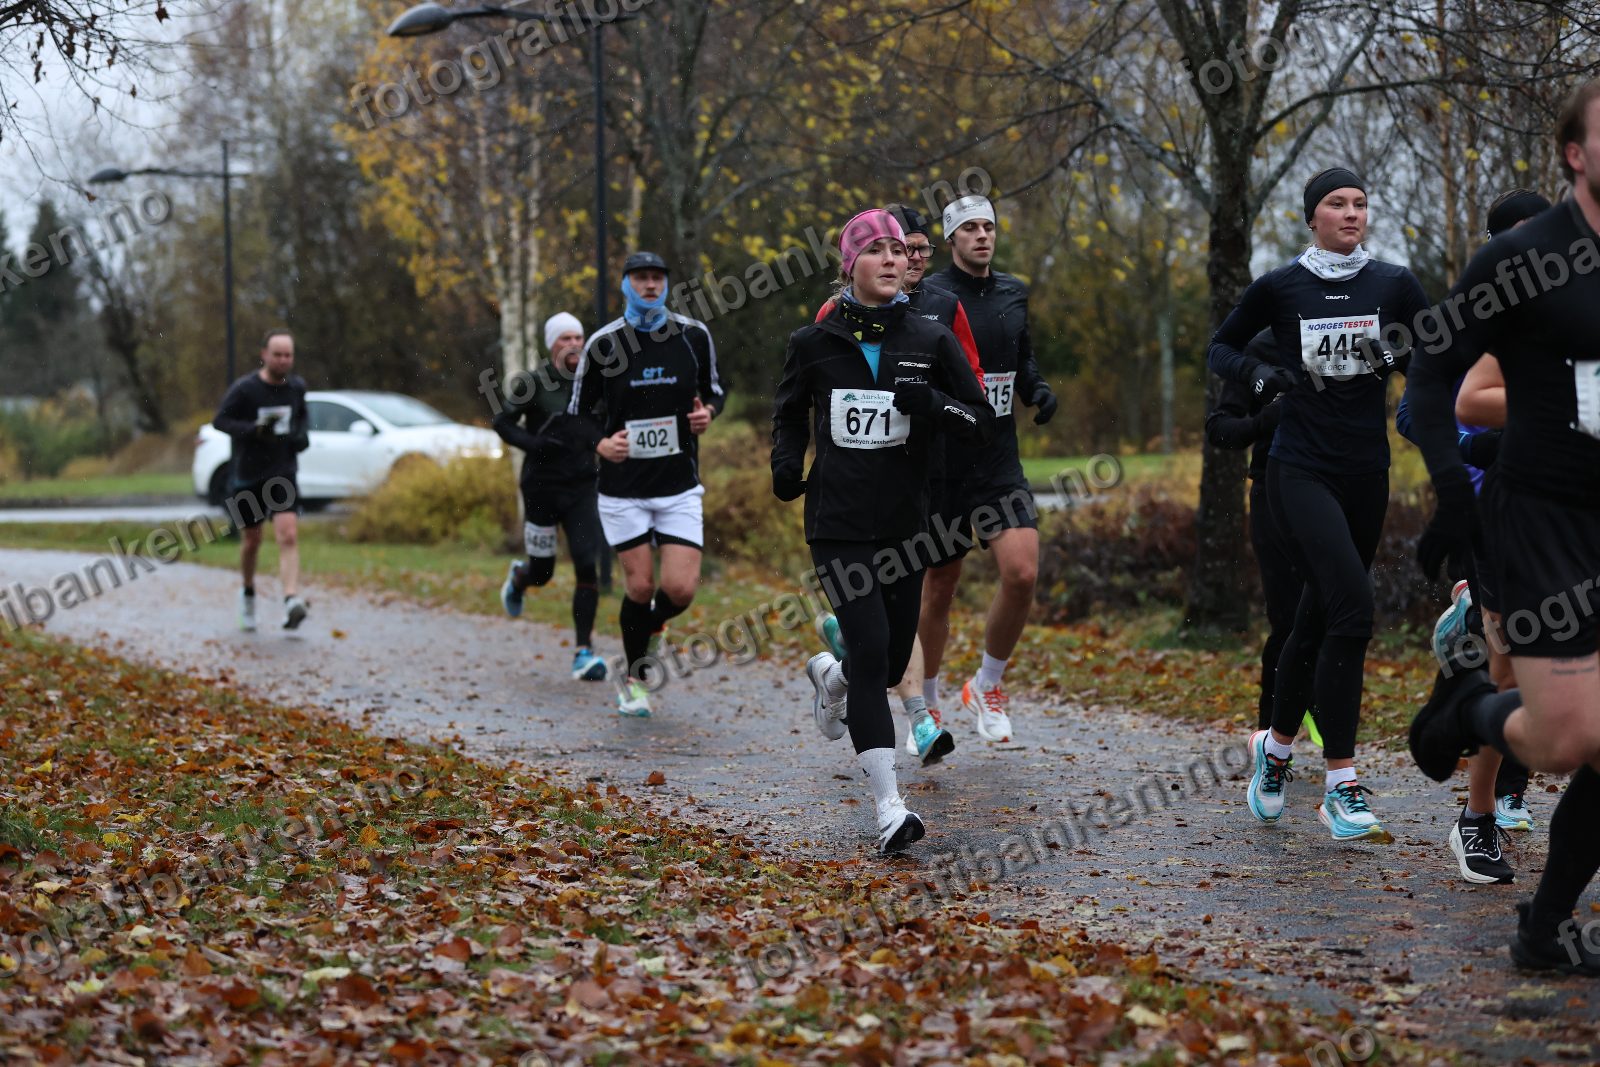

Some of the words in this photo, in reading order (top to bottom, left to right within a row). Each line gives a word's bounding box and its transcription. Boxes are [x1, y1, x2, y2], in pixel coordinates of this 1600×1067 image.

[1308, 319, 1374, 331] NORGESTESTEN
[897, 361, 932, 369] FISCHER
[860, 393, 891, 402] Aurskog
[846, 406, 891, 437] 671
[943, 405, 977, 425] FISCHER
[636, 428, 669, 449] 402
